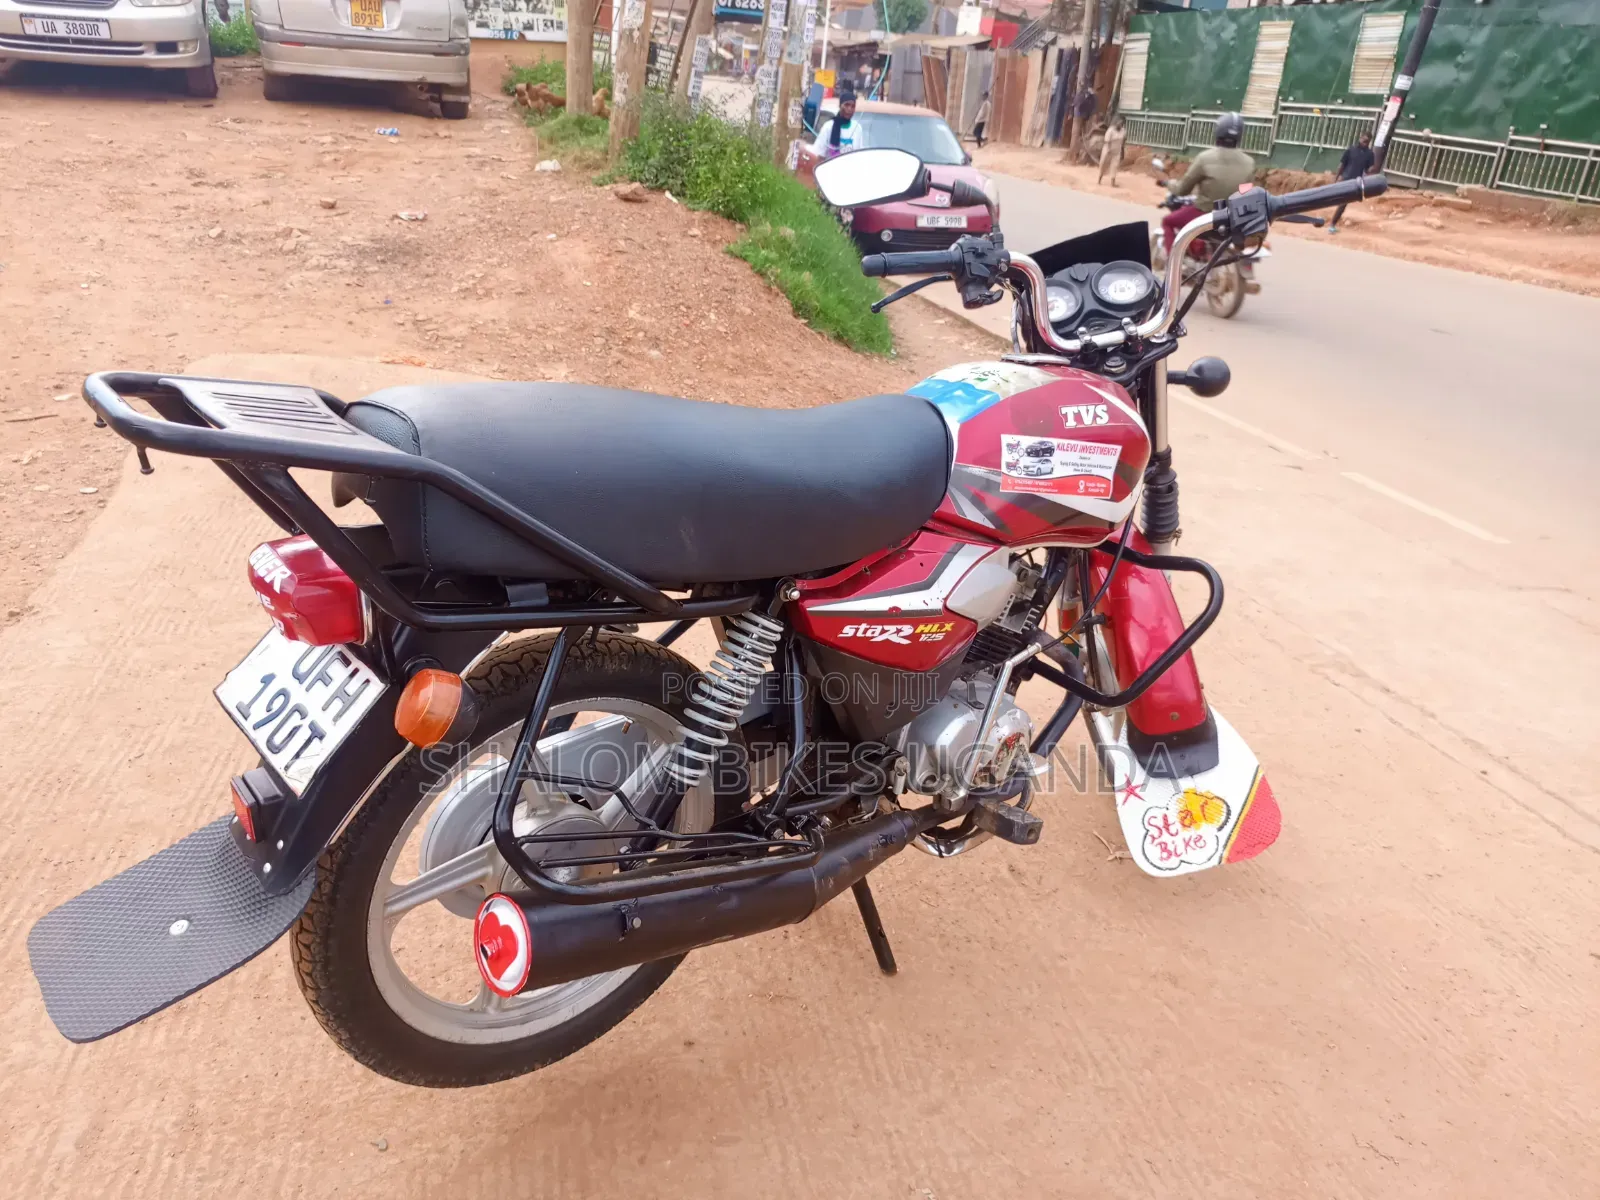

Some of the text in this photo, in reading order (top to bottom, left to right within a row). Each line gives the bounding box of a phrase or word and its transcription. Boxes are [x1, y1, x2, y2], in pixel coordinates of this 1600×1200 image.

[354, 12, 380, 25] 891F
[41, 20, 101, 37] UA 388DR
[1060, 404, 1110, 428] TVS
[915, 622, 956, 634] HLX
[918, 633, 946, 642] 125
